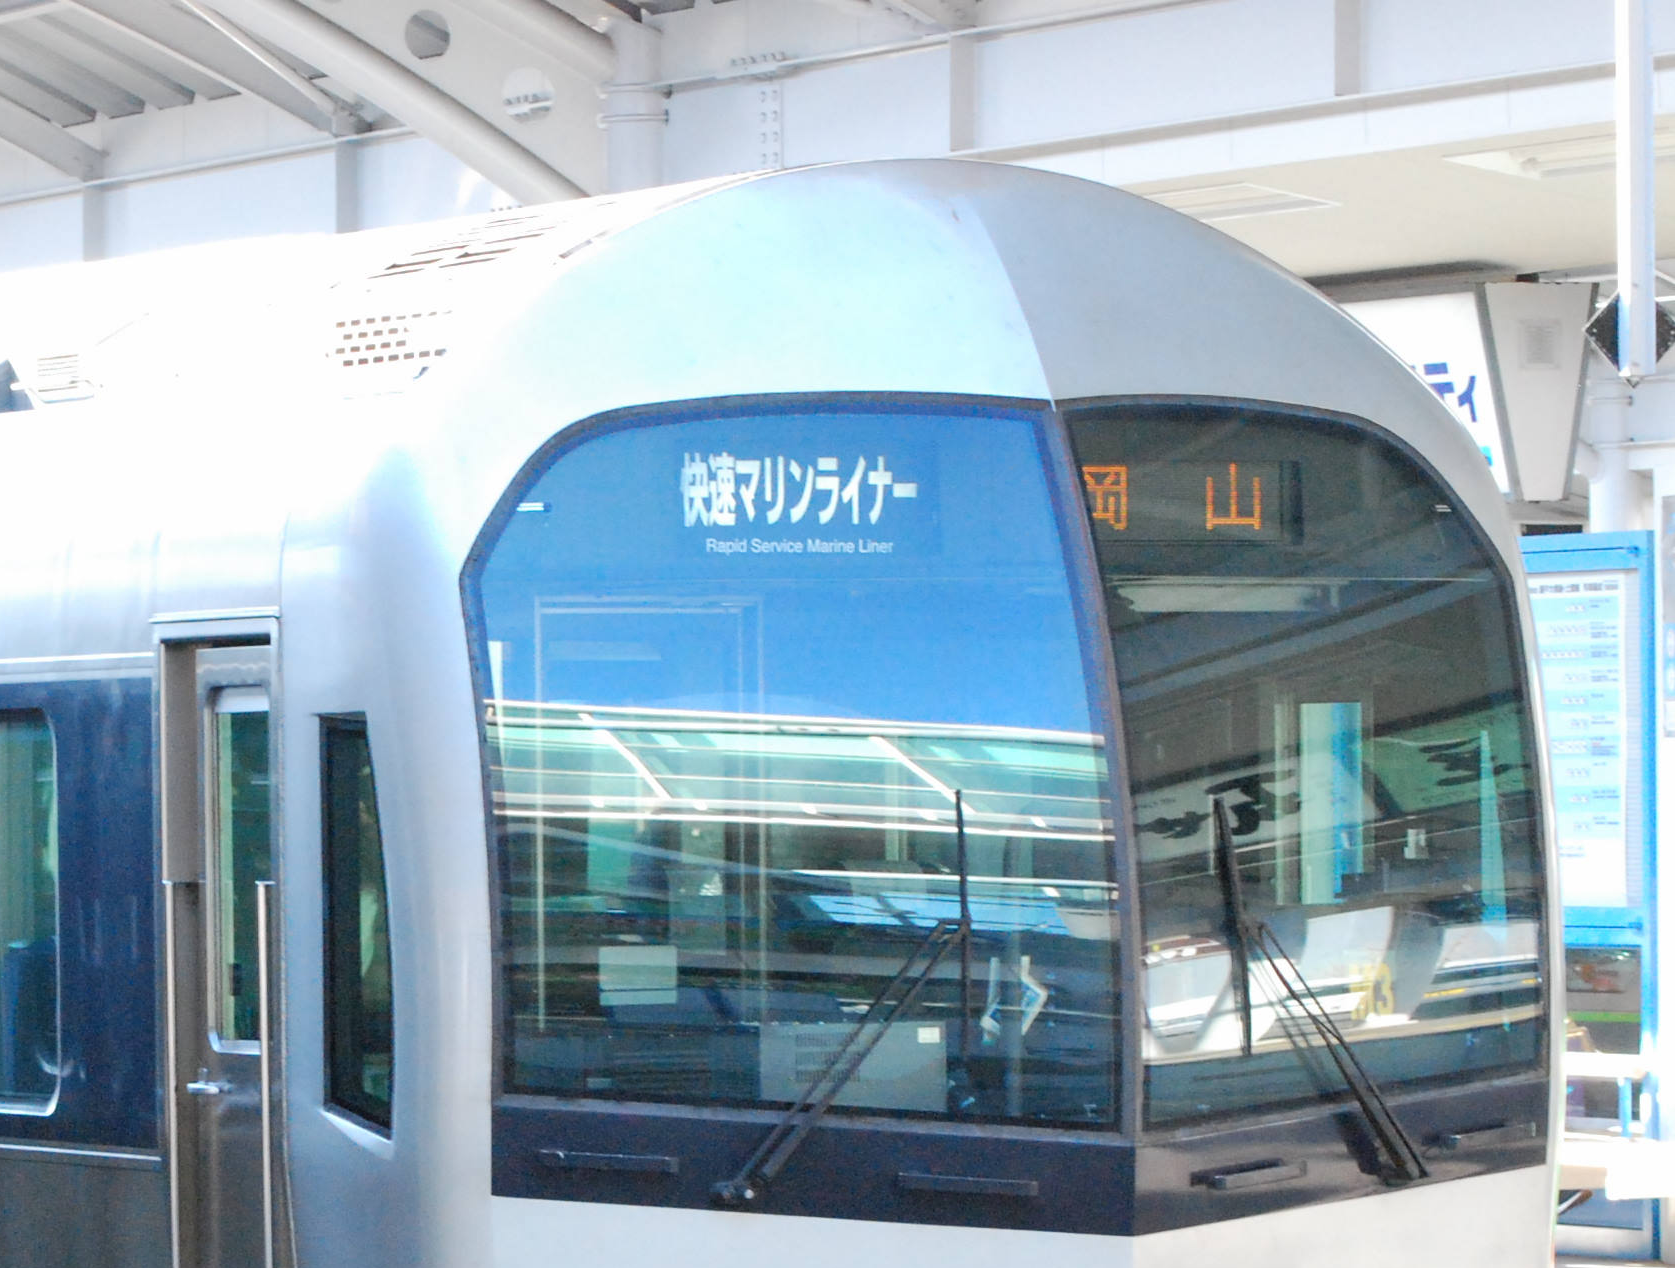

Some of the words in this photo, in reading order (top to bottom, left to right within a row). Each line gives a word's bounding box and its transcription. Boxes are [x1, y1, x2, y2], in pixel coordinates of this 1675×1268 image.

[680, 452, 918, 527] 快速マリンライナー
[1082, 462, 1262, 530] 岡山
[706, 538, 747, 556] Rapid
[751, 538, 804, 554] Service
[807, 538, 855, 554] Marine
[859, 539, 894, 554] Liner
